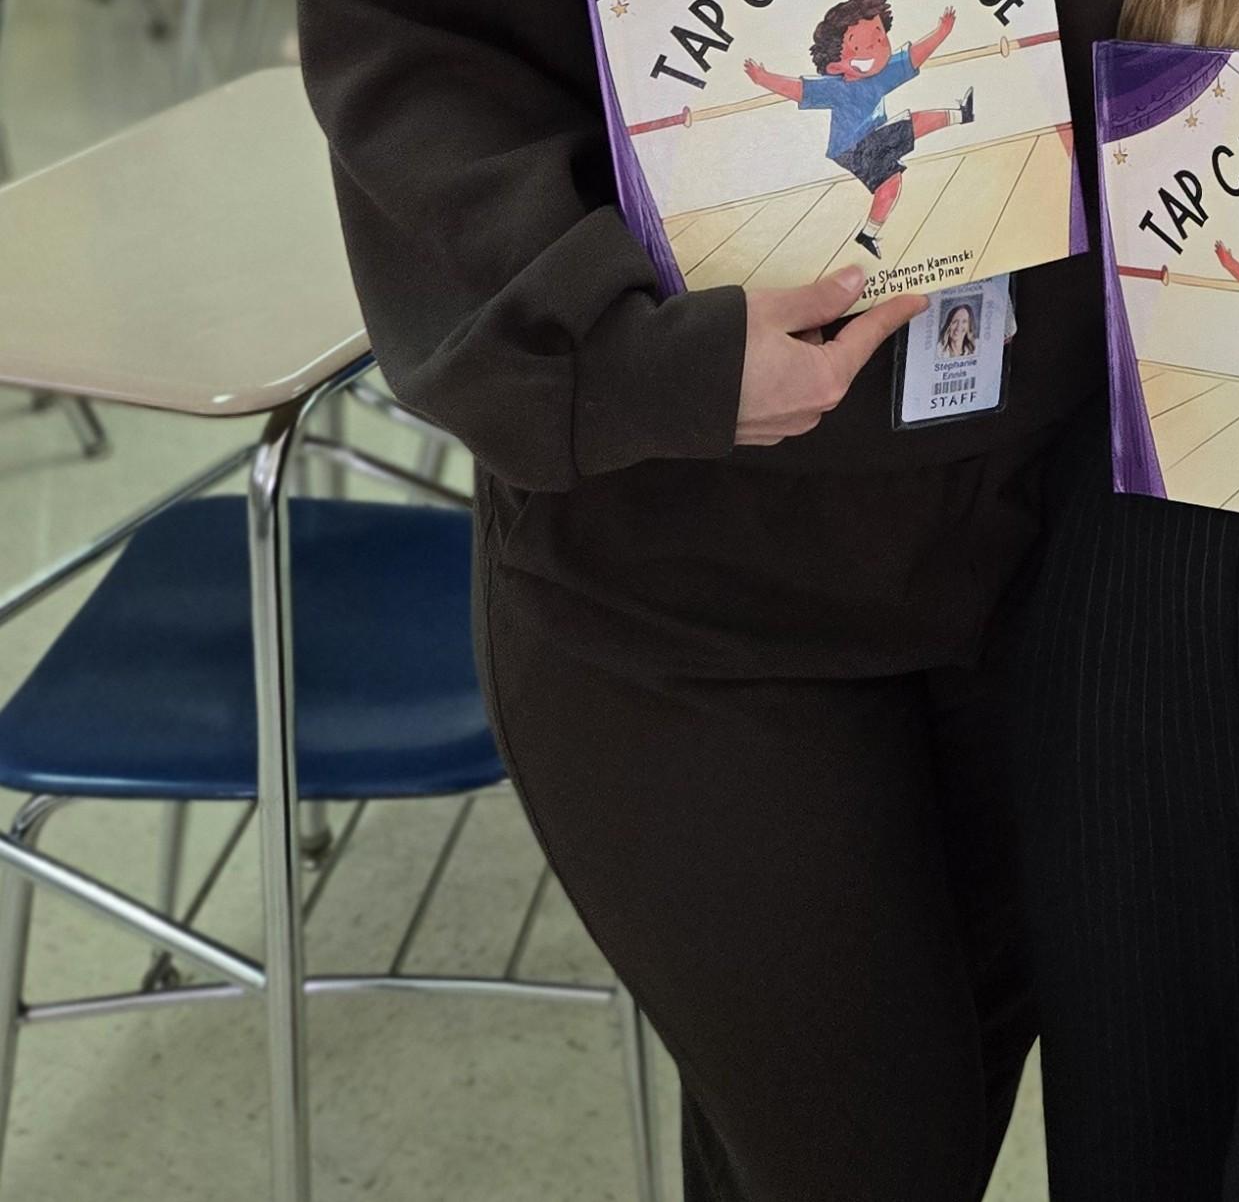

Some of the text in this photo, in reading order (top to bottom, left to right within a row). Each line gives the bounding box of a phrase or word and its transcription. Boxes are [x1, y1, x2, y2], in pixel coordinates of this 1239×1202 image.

[1139, 169, 1209, 254] TAP
[878, 263, 925, 284] Shannon
[926, 249, 974, 272] Kaminski
[889, 281, 903, 293] by
[905, 273, 936, 290] Hafsa
[934, 359, 977, 372] Stephanie
[930, 391, 977, 409] STAFF
